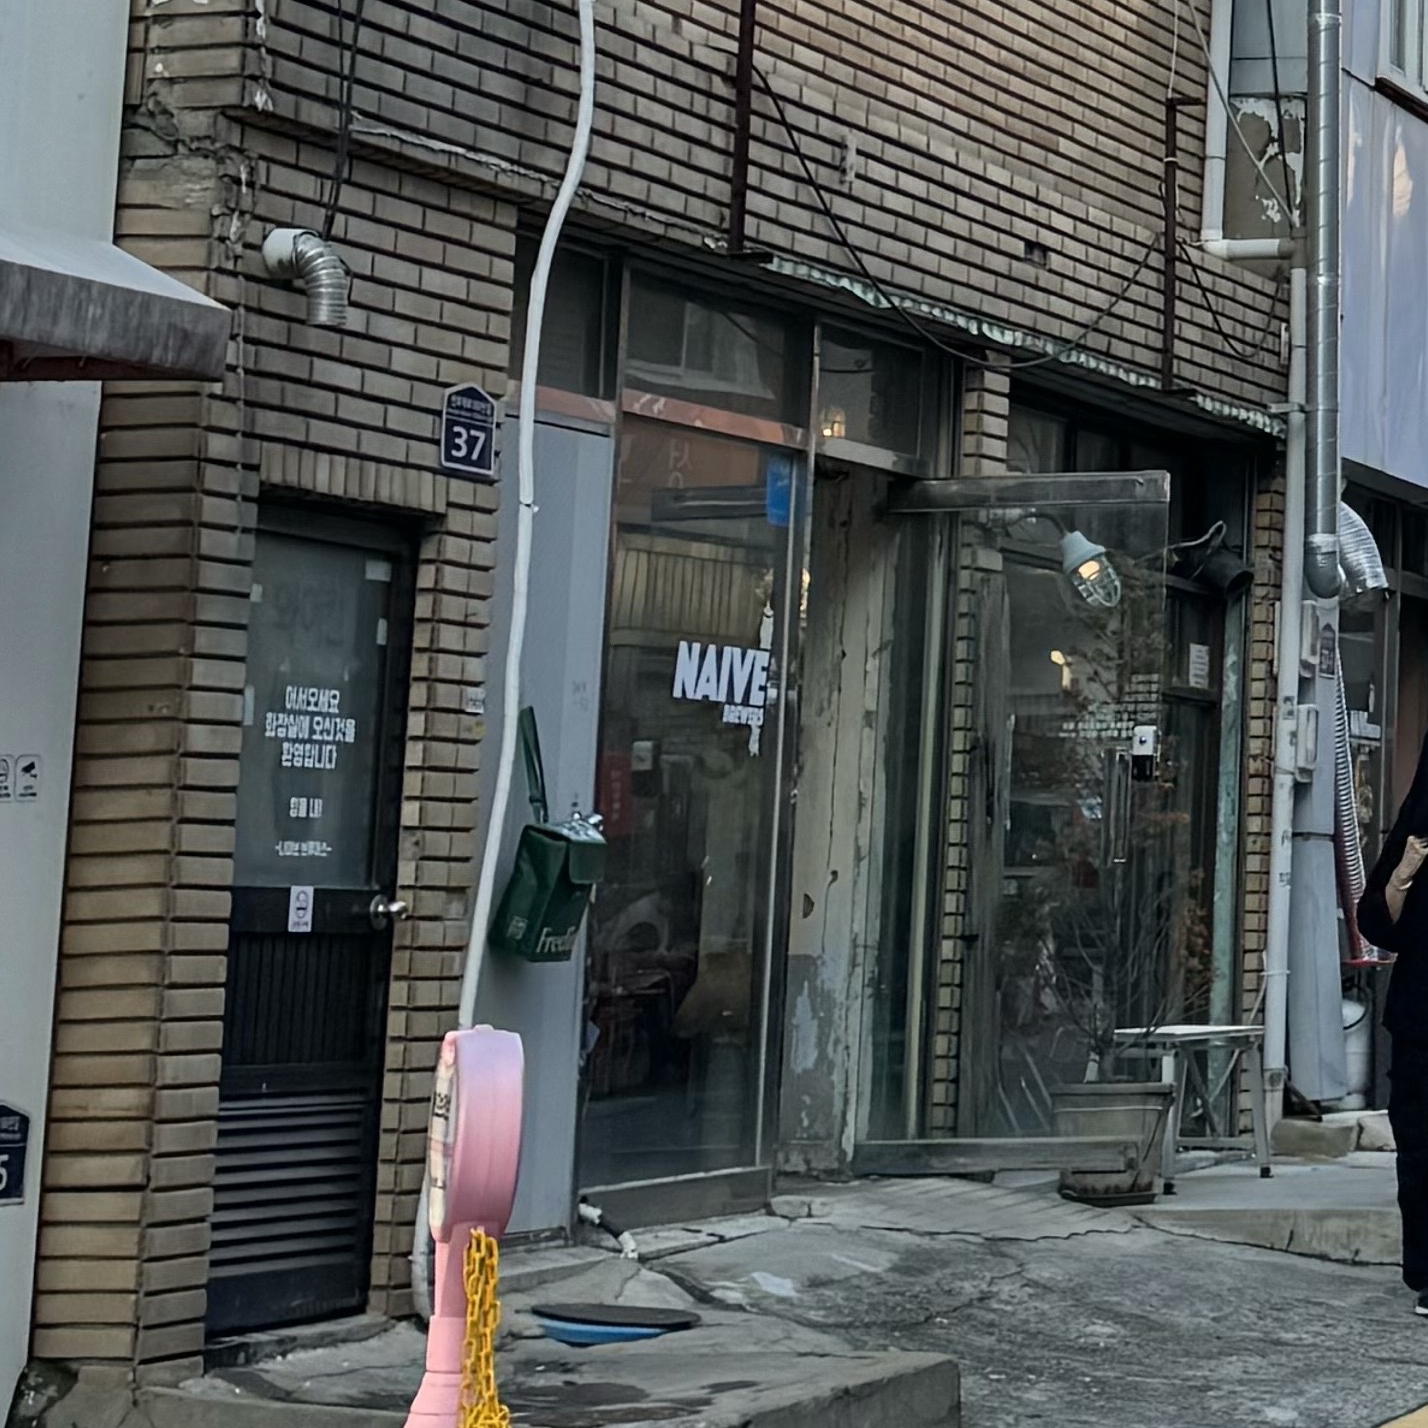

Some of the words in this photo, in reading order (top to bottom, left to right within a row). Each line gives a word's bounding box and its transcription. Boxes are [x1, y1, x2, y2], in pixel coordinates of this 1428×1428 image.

[451, 425, 486, 461] 37
[672, 640, 770, 706] NAIVE
[285, 686, 340, 713] 어서오세요
[281, 741, 337, 769] 환영합니다
